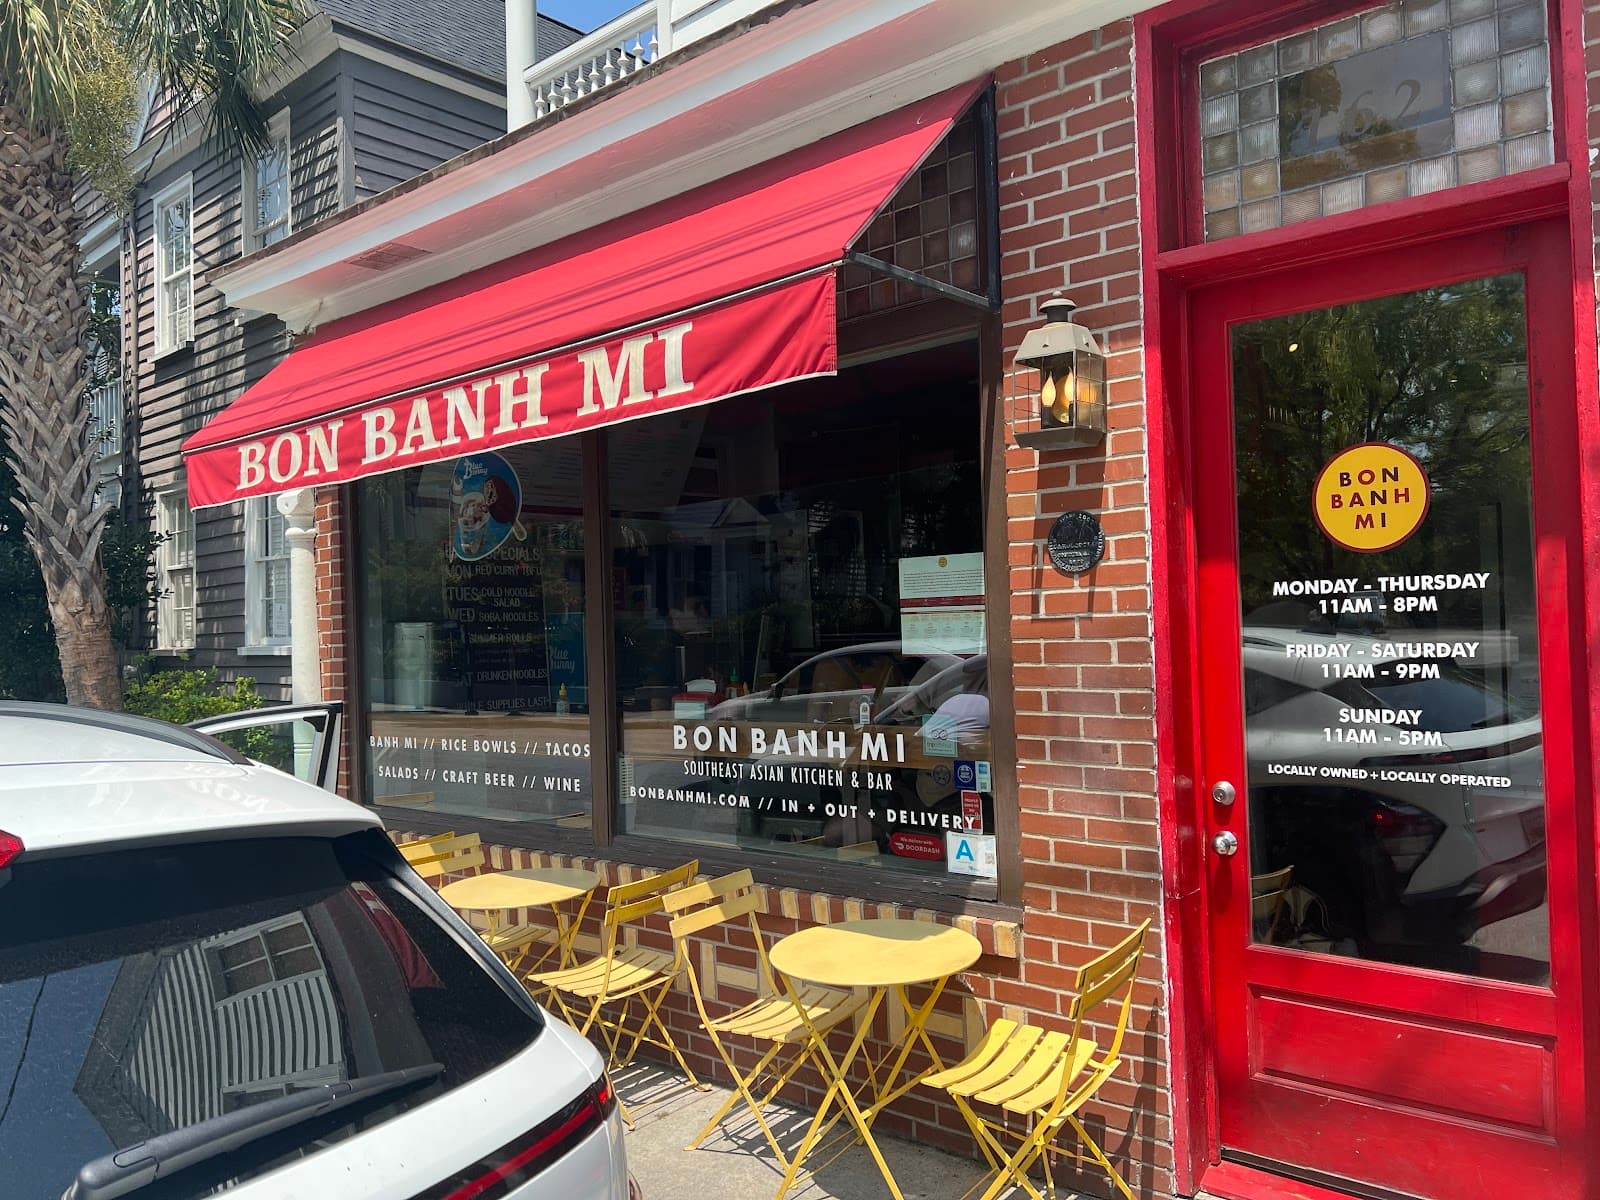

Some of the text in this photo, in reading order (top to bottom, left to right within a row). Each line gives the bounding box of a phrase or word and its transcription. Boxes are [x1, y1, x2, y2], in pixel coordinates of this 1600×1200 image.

[236, 419, 343, 491] BON
[360, 361, 549, 466] BANH
[576, 321, 695, 415] MI
[1339, 466, 1400, 488] BON
[1331, 487, 1410, 509] BANH
[1354, 512, 1387, 530] MI
[1272, 578, 1358, 596] MONDAY
[1378, 573, 1490, 592] THURSDAY
[1318, 598, 1373, 614] 11AM
[1393, 596, 1438, 613] 8PM
[1285, 643, 1352, 659] FRIDAY
[1371, 642, 1480, 659] SATURDAY
[1321, 663, 1376, 679] 11AM
[1395, 664, 1441, 679] 9PM
[486, 696, 526, 710] SUPPLIES
[1339, 708, 1423, 725] SUNDAY
[369, 735, 591, 758] BANH MI // RICE BOWLS // TACOS
[673, 725, 905, 763] BON BANH MI
[1323, 728, 1377, 744] 11AM
[1398, 730, 1443, 747] 5PM
[378, 765, 581, 793] SALADS // CRAFT BEER // WINE
[684, 760, 893, 791] SOUTHEAST ASIAN KITCHEN & BAR
[1268, 763, 1512, 788] LOCALLY OWNED + LOCALLY OPERATED
[630, 786, 750, 809] BONBANHMI.COM
[757, 797, 774, 810] //
[782, 799, 798, 813] IN
[807, 803, 816, 813] +
[825, 803, 858, 819] OUT
[867, 809, 876, 819] +
[887, 809, 975, 830] DELIVERY
[905, 844, 940, 855] DOORDASH
[956, 839, 975, 862] A
